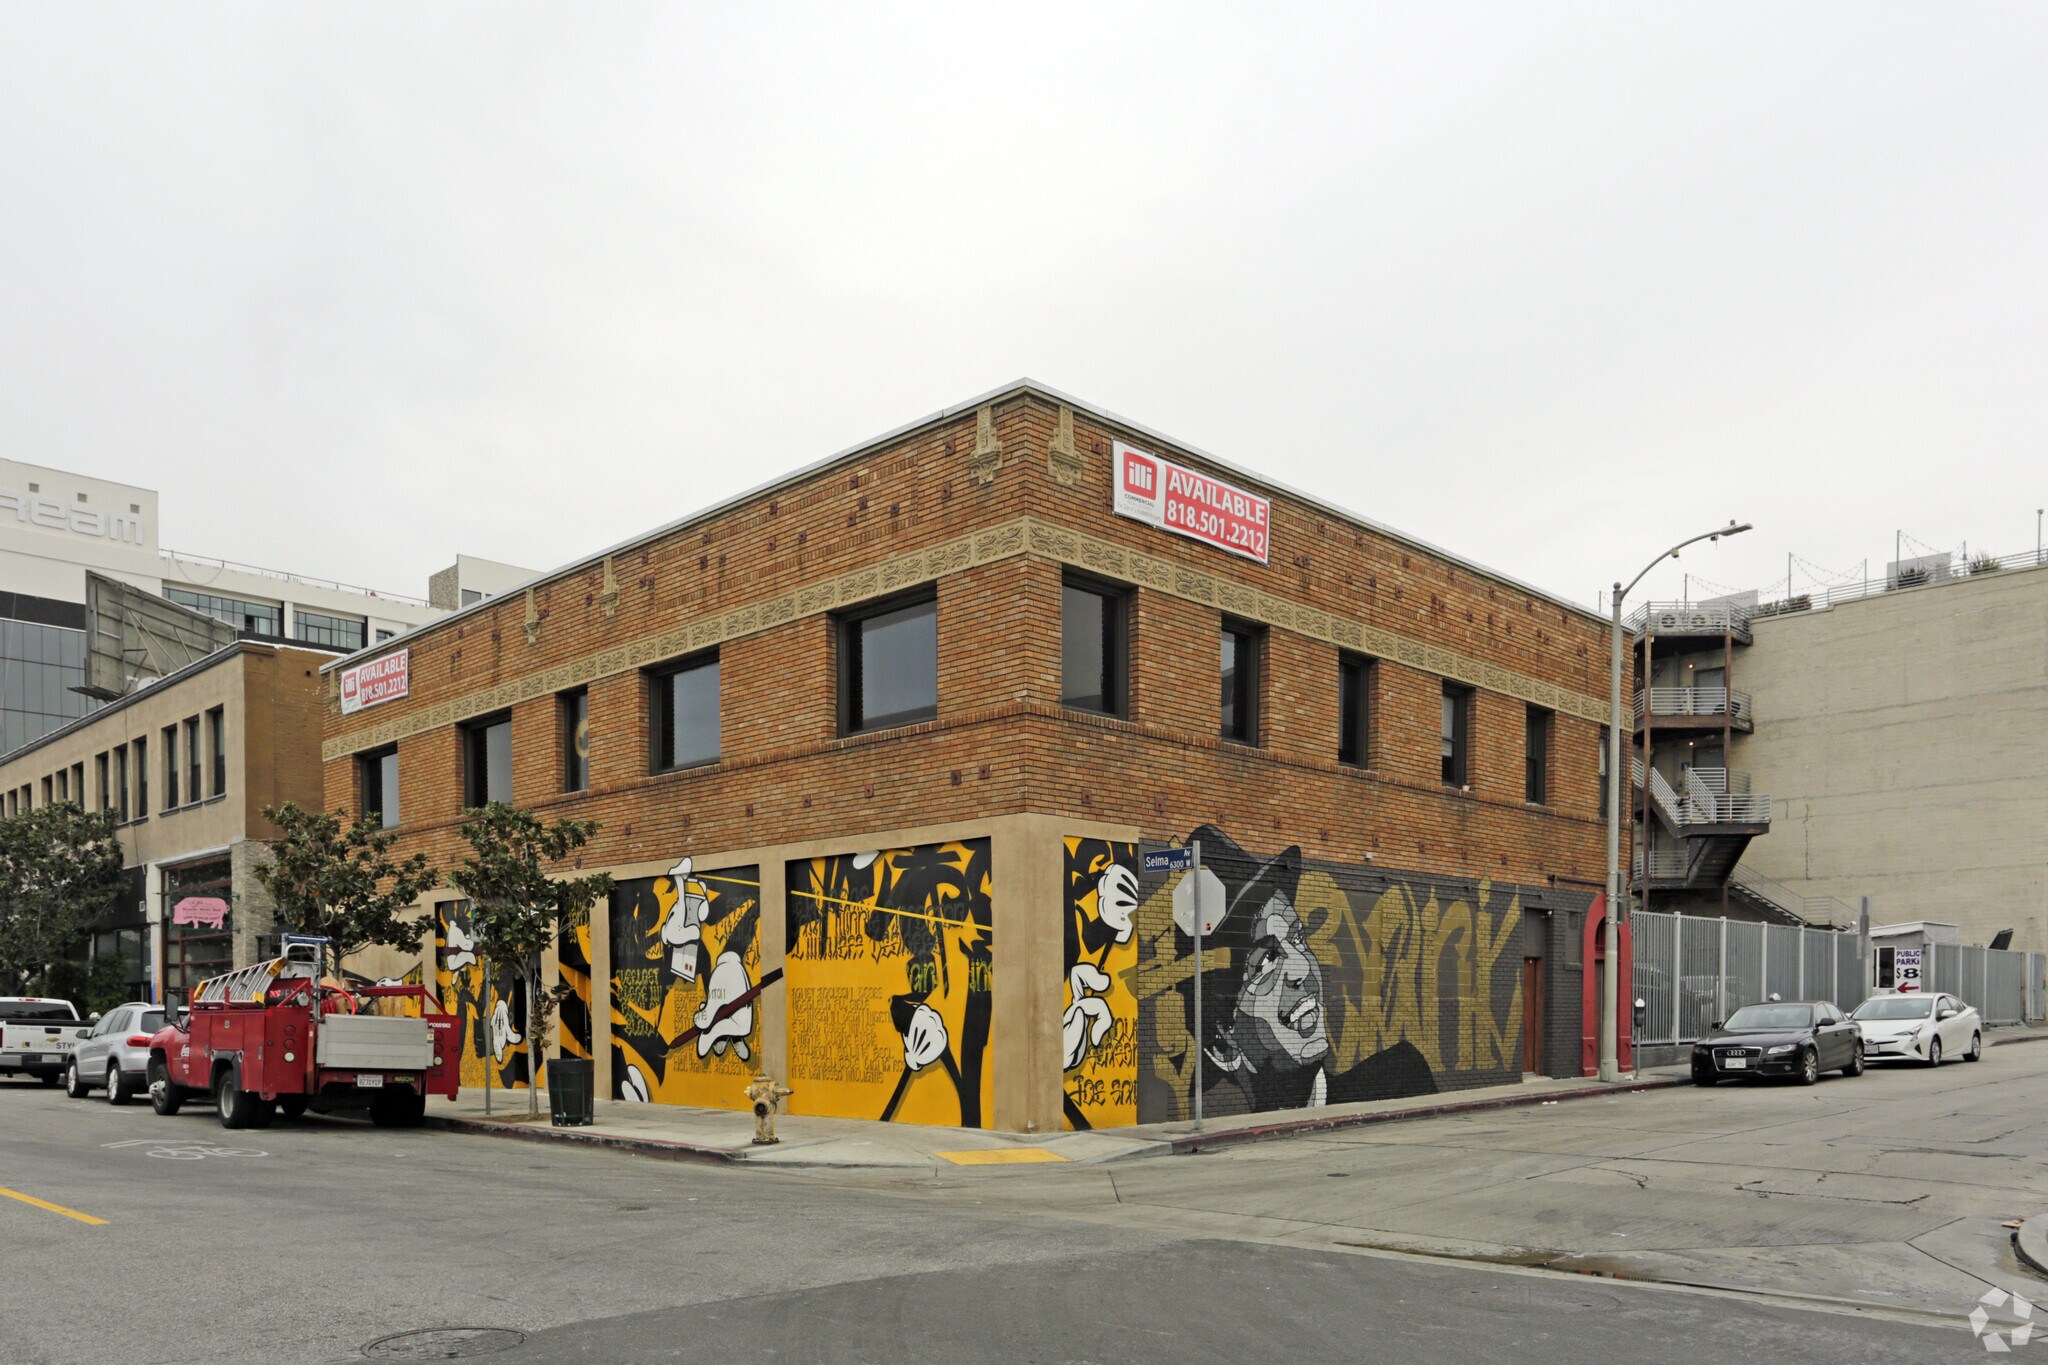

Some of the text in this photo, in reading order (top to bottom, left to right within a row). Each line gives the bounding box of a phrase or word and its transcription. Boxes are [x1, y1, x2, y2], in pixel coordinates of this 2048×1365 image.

[1124, 493, 1156, 508] COMMERCIAL
[1168, 470, 1266, 526] AVAILABLE
[1166, 499, 1265, 554] 818.501.2212
[360, 655, 407, 684] AVAILABLE
[361, 675, 406, 703] 818.501.2212
[1145, 856, 1169, 868] Selma
[1169, 860, 1184, 869] 6300
